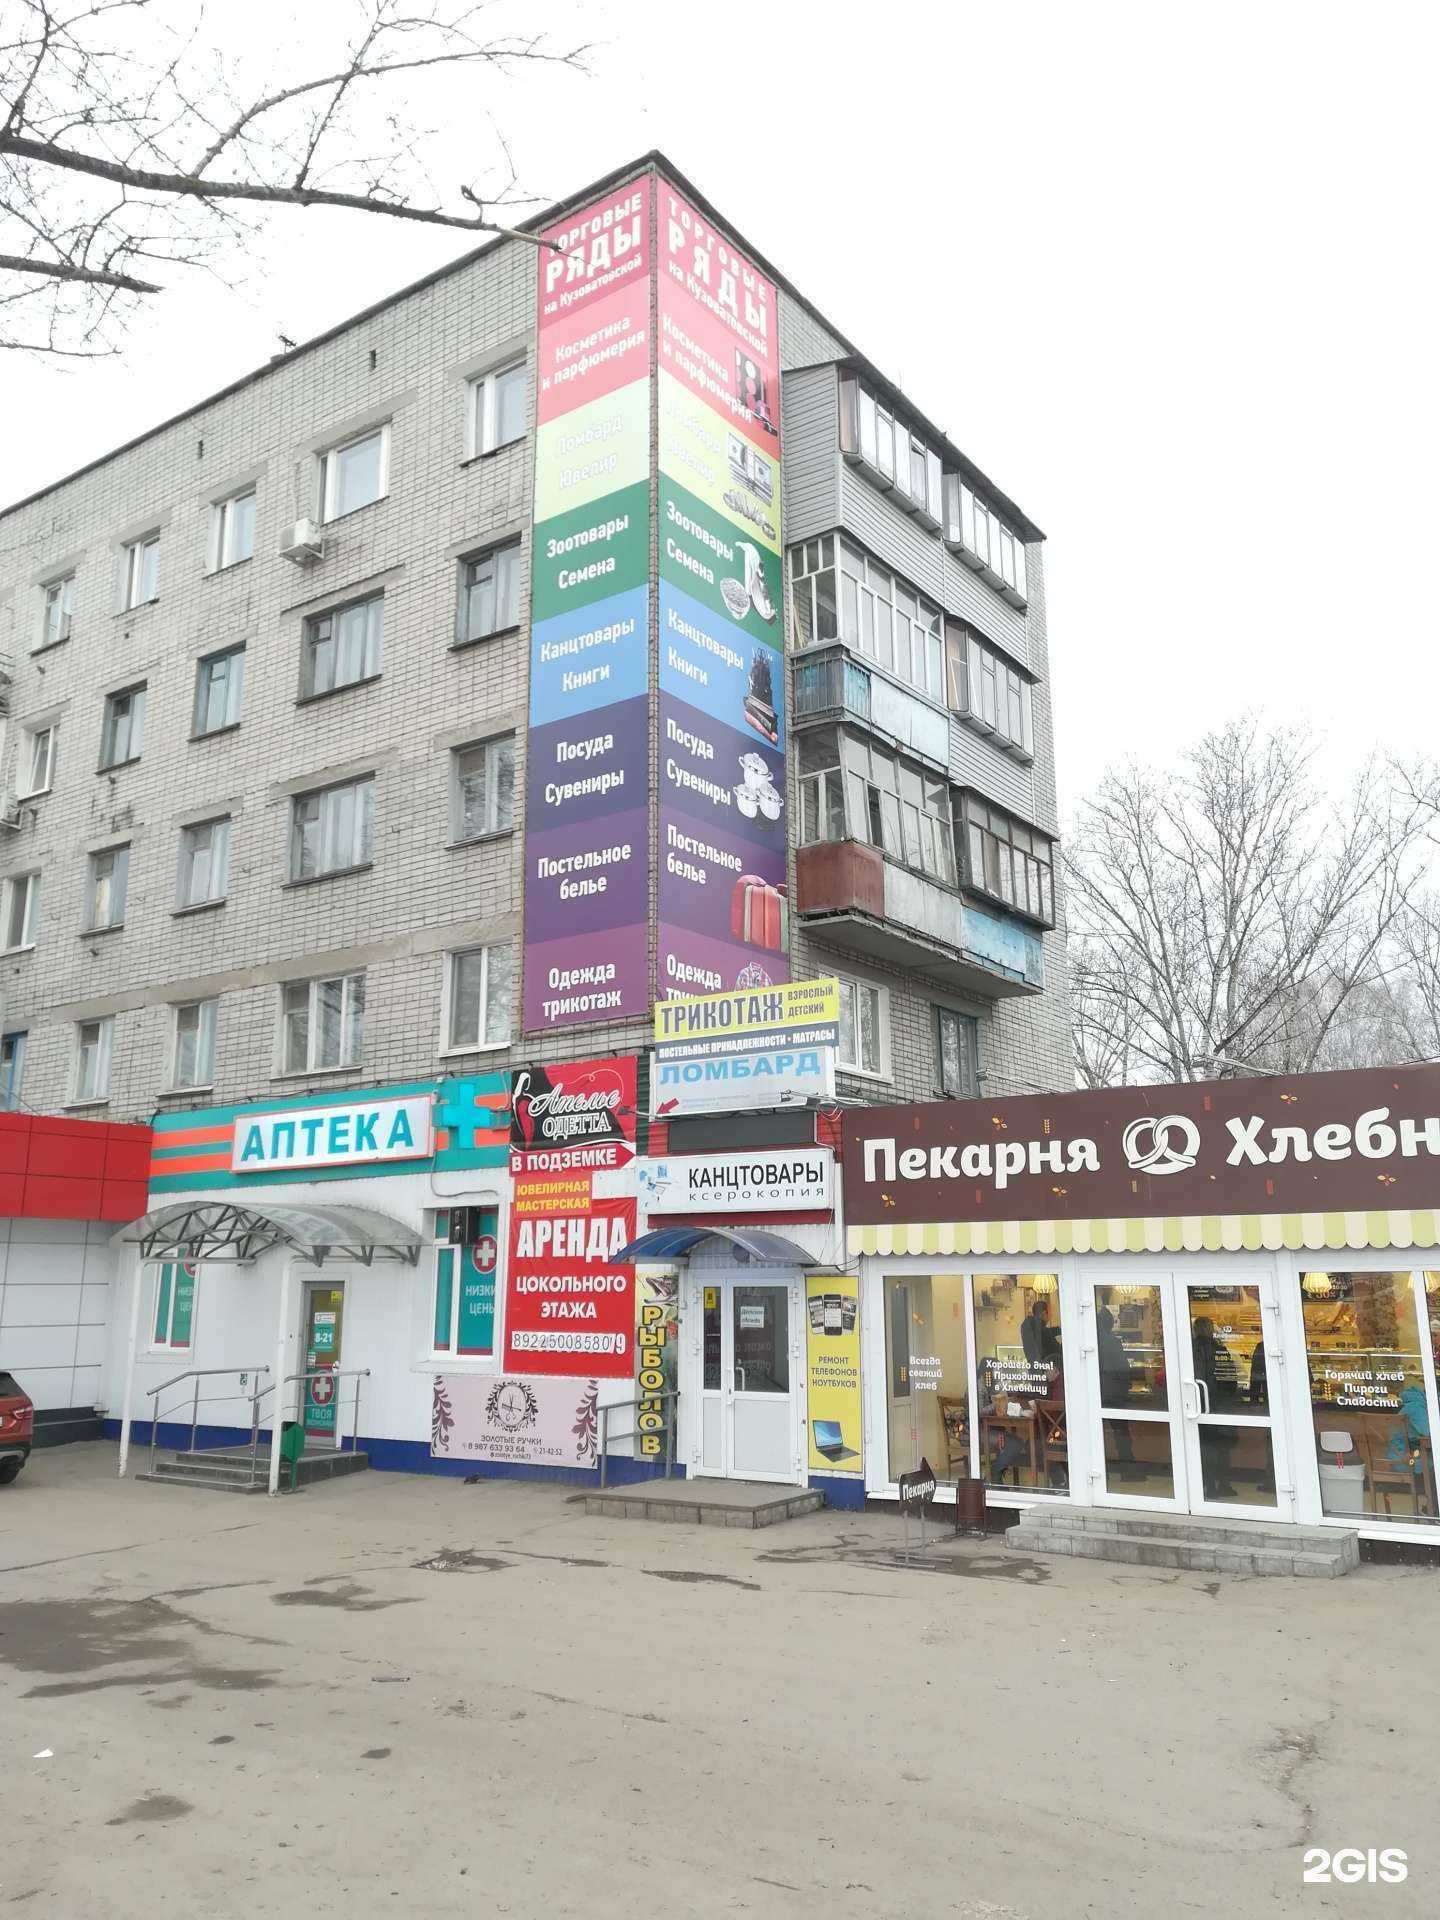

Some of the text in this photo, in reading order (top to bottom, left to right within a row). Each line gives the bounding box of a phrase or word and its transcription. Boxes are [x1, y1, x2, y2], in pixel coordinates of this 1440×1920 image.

[546, 214, 641, 293] РЯДЫ
[668, 196, 766, 303] ТОРГОВЫЕ
[668, 218, 767, 337] РЯДЫ
[669, 260, 683, 282] на
[544, 301, 557, 315] на
[555, 316, 631, 363] Косметика
[662, 313, 729, 383] Косметика
[542, 330, 645, 390] и парфюмерия
[662, 339, 752, 423] и парфюмерия
[546, 515, 629, 559] Зоотовары
[666, 500, 734, 562] Зоотовары
[558, 556, 616, 589] Семена
[666, 537, 714, 584] Семена
[540, 618, 635, 663] Канцтовары
[667, 608, 744, 671] Канцтовары
[562, 664, 610, 692] Книги
[667, 646, 708, 685] Книги
[556, 734, 614, 763] Посуда
[666, 718, 714, 760] Посуда
[545, 769, 624, 807] Сувениры
[666, 758, 731, 806] Сувениры
[538, 844, 631, 879] Постельное
[666, 823, 743, 873] Постельное
[666, 852, 707, 885] белье
[560, 876, 607, 900] белье
[549, 962, 616, 989] Одежда
[666, 954, 722, 991] Одежда
[542, 989, 622, 1021] трикотаж
[787, 984, 833, 1001] ВЗРОСЛЫЙ
[661, 992, 784, 1034] ТРИКОТАЖ
[788, 1002, 825, 1018] ДЕТСКИЙ
[659, 1029, 835, 1059] ПОСТЕЛЬНЫЕ ПРИНАДЛЕЖНОСТИ МАТРАСЫ
[660, 1052, 821, 1085] ЛОМБАРД
[529, 1083, 620, 1117] Ателье
[241, 1108, 414, 1162] АПТЕКА
[542, 1111, 612, 1140] ОДЕТТА
[511, 1147, 617, 1173] В ПОДЗЕМКЕ
[863, 1106, 1440, 1190] Пекарня Хлебн
[516, 1180, 590, 1196] ЮВЕЛИРНАЯ
[689, 1161, 824, 1190] КАНЦТОВАРЫ
[516, 1196, 590, 1212] МАСТЕРСКАЯ
[689, 1187, 825, 1202] ксерокопия
[516, 1217, 628, 1263] АРЕНДА
[516, 1275, 627, 1294] ЦОКОЛЬНОГО
[541, 1301, 597, 1319] ЭТАЖА
[811, 1367, 858, 1377] ТЕЛЕФОНОВ
[818, 1356, 849, 1365] РЕМОНТ
[909, 1356, 941, 1366] Всегда
[986, 1360, 1054, 1370] Хорошего дня!
[994, 1371, 1047, 1381] Приходите
[1324, 1369, 1405, 1382] Горячий хлеб
[638, 1304, 667, 1455] РЫБОЛОВ
[812, 1378, 857, 1388] НОУТБУКОВ
[914, 1382, 938, 1391] хлеб
[1344, 1384, 1388, 1395] Пироги
[1336, 1396, 1399, 1408] Сладости
[902, 1480, 935, 1501] Пекарня
